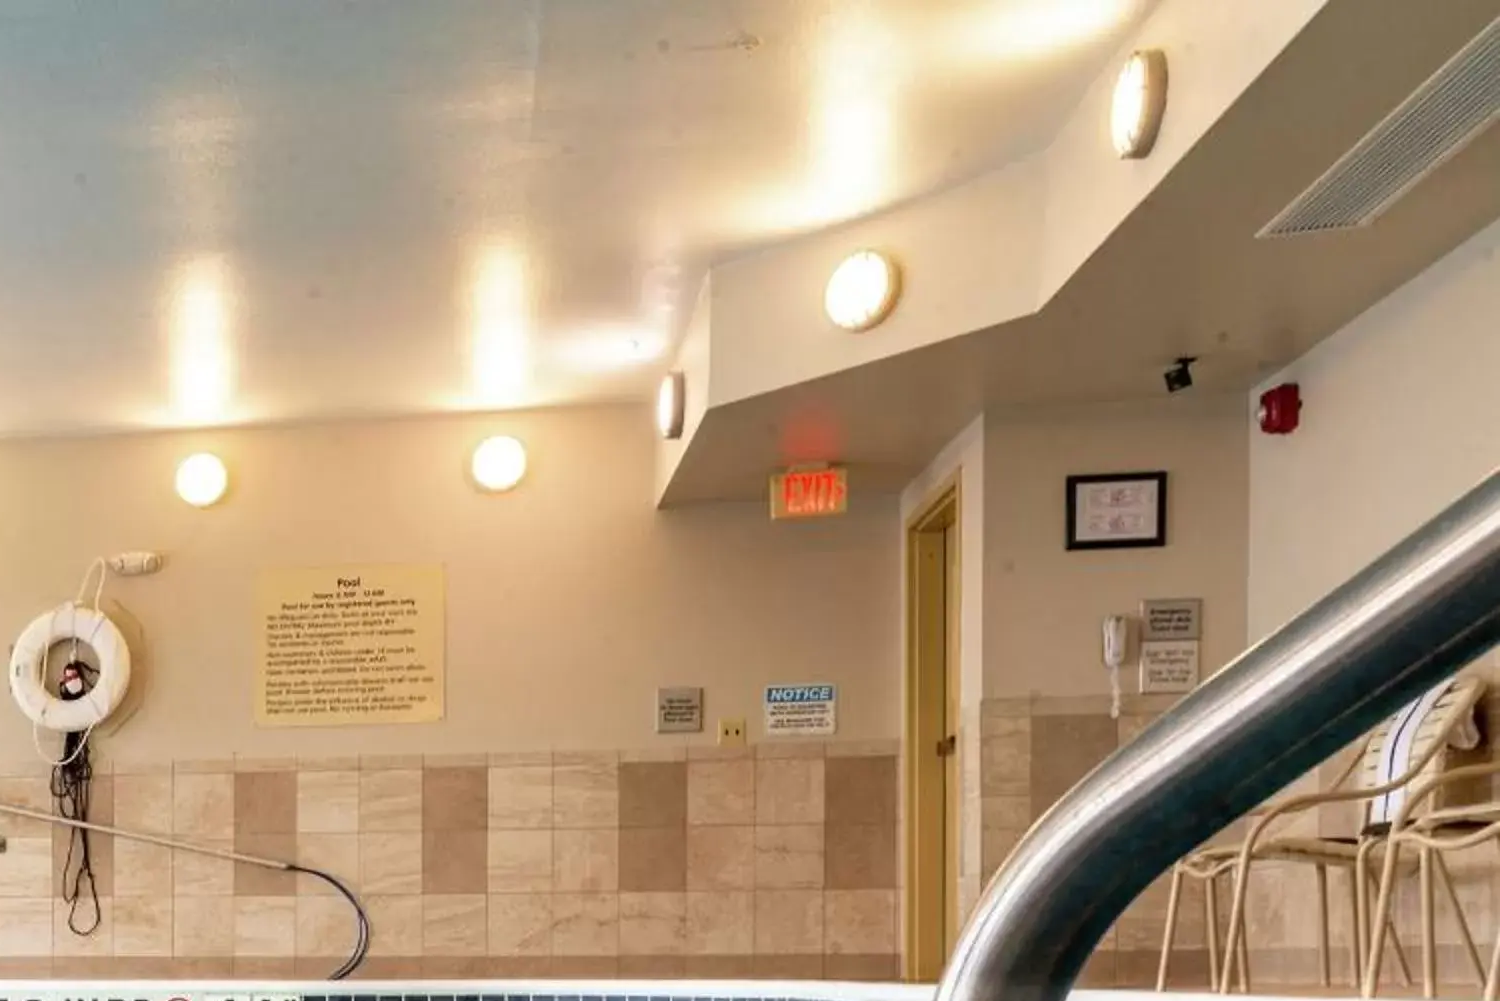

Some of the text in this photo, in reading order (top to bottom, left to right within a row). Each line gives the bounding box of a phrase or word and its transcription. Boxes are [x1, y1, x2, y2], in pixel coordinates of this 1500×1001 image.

[784, 472, 836, 513] EXIT
[337, 576, 361, 589] Pool
[769, 687, 831, 702] NOTICE
